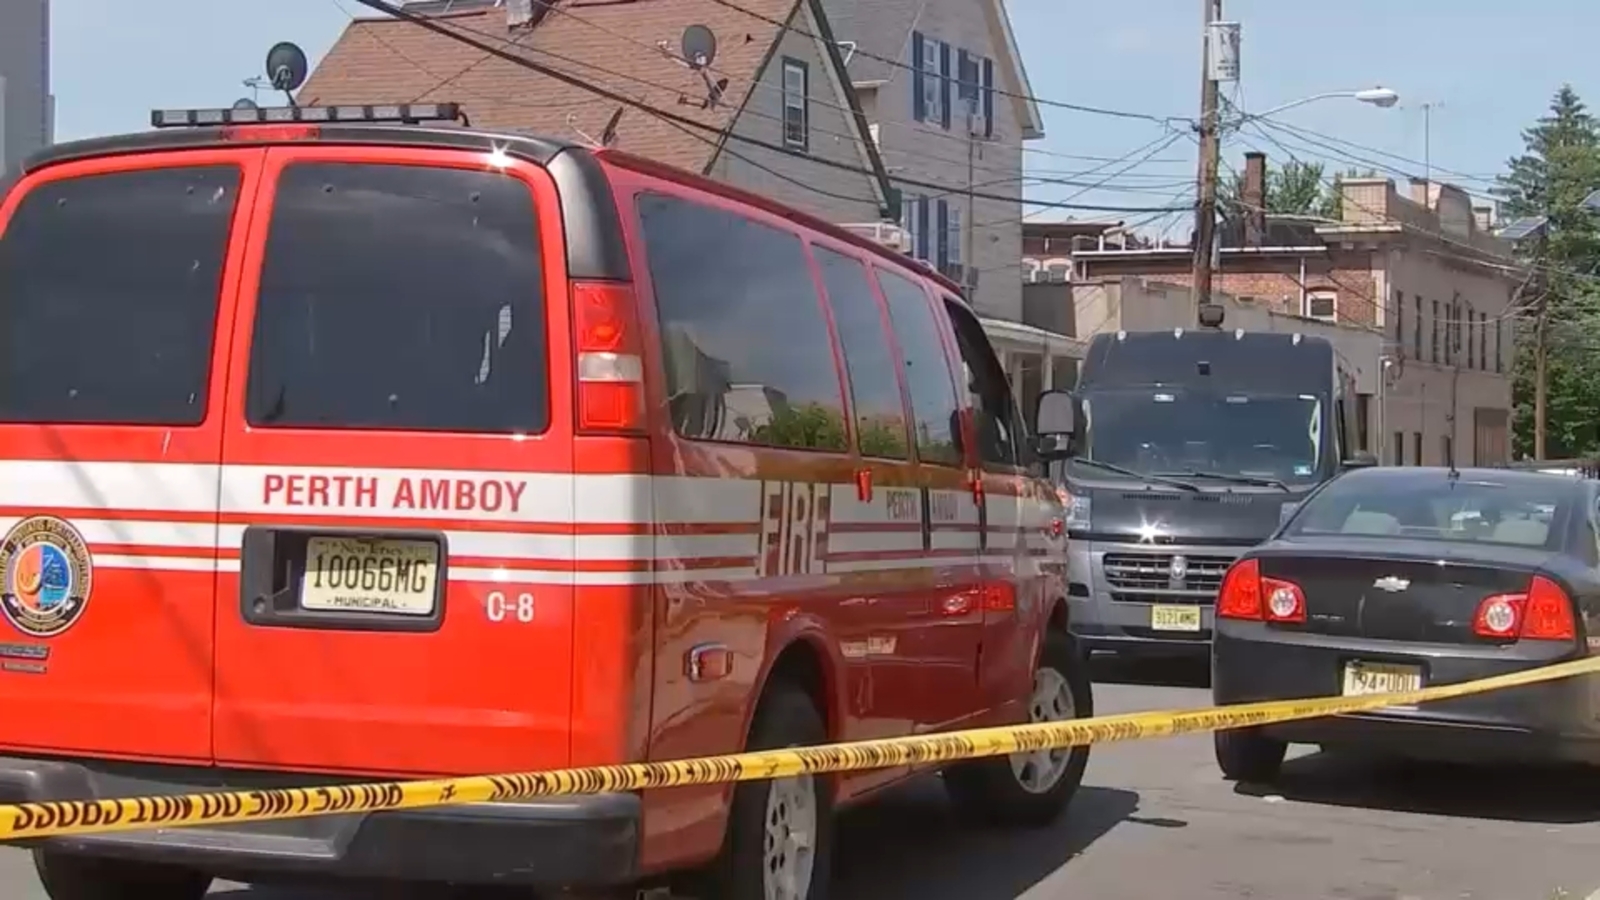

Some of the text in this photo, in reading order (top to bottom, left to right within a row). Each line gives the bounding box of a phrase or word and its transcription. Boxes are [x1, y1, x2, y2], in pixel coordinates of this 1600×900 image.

[263, 474, 527, 512] PERTH AMBOY
[760, 480, 829, 577] FIRE
[314, 555, 427, 593] 10066MG
[334, 596, 398, 610] MUNICIPAL
